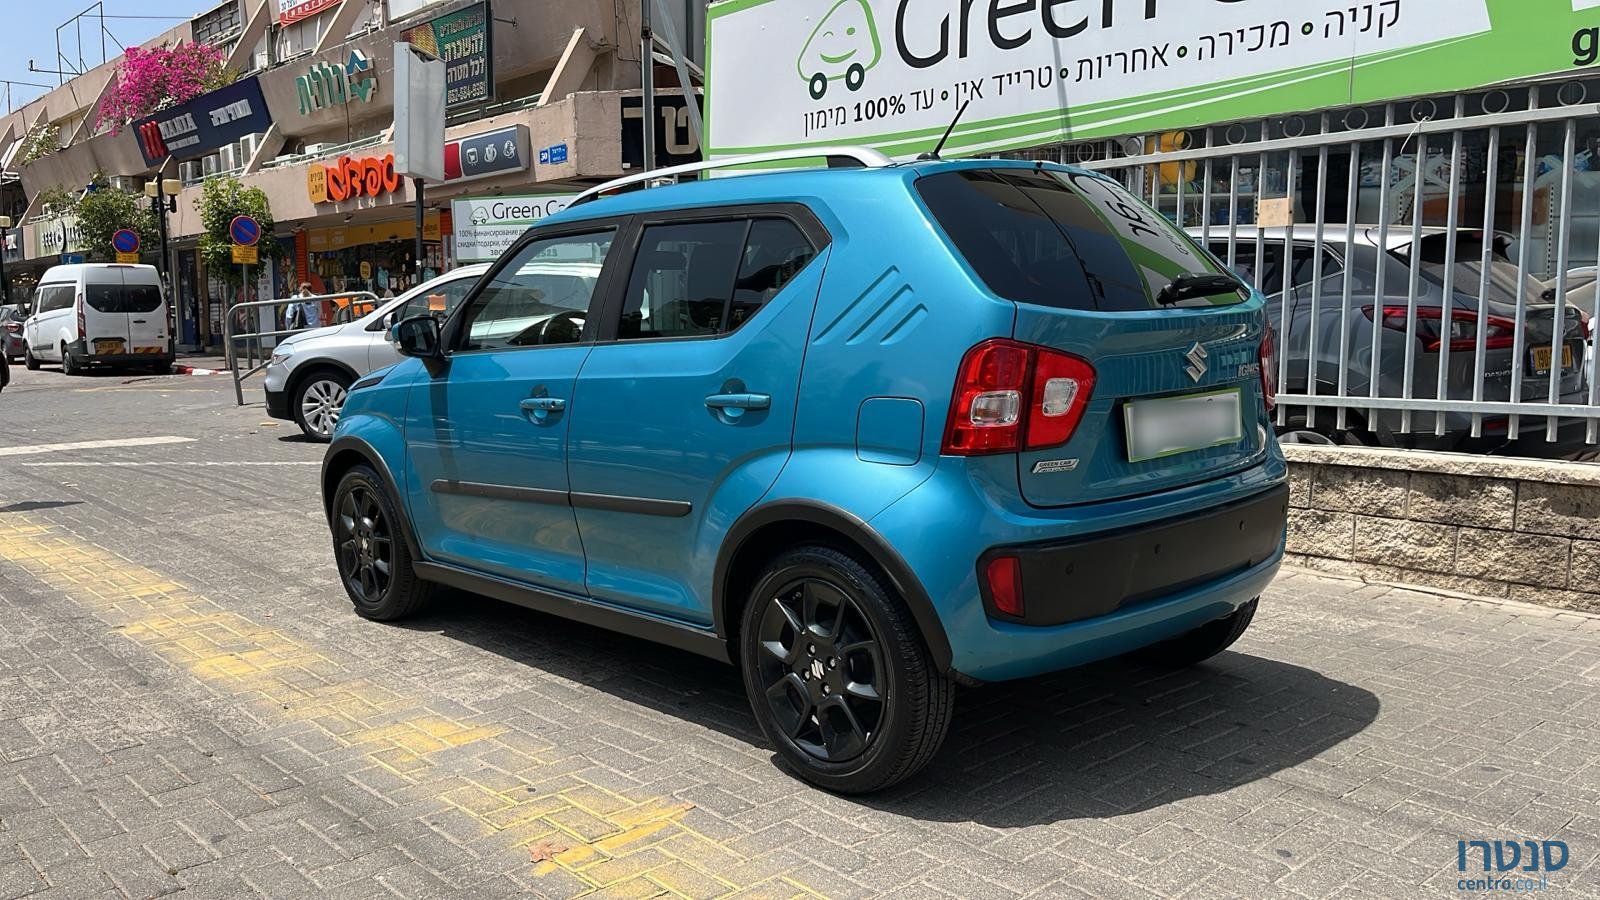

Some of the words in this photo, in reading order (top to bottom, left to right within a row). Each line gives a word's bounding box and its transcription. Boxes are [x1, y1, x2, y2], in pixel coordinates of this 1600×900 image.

[1323, 0, 1401, 39] קניה
[1198, 20, 1290, 61] מכירה
[447, 63, 469, 84] מטרה
[470, 56, 485, 76] לכל
[1075, 43, 1170, 83] אחריות
[954, 78, 984, 111] אין
[991, 65, 1053, 96] טרייד
[853, 93, 906, 123] 100%
[910, 88, 934, 111] עד
[804, 106, 846, 138] מימון
[492, 202, 541, 220] Green
[459, 230, 473, 238] 100%
[474, 229, 518, 239] финансирование
